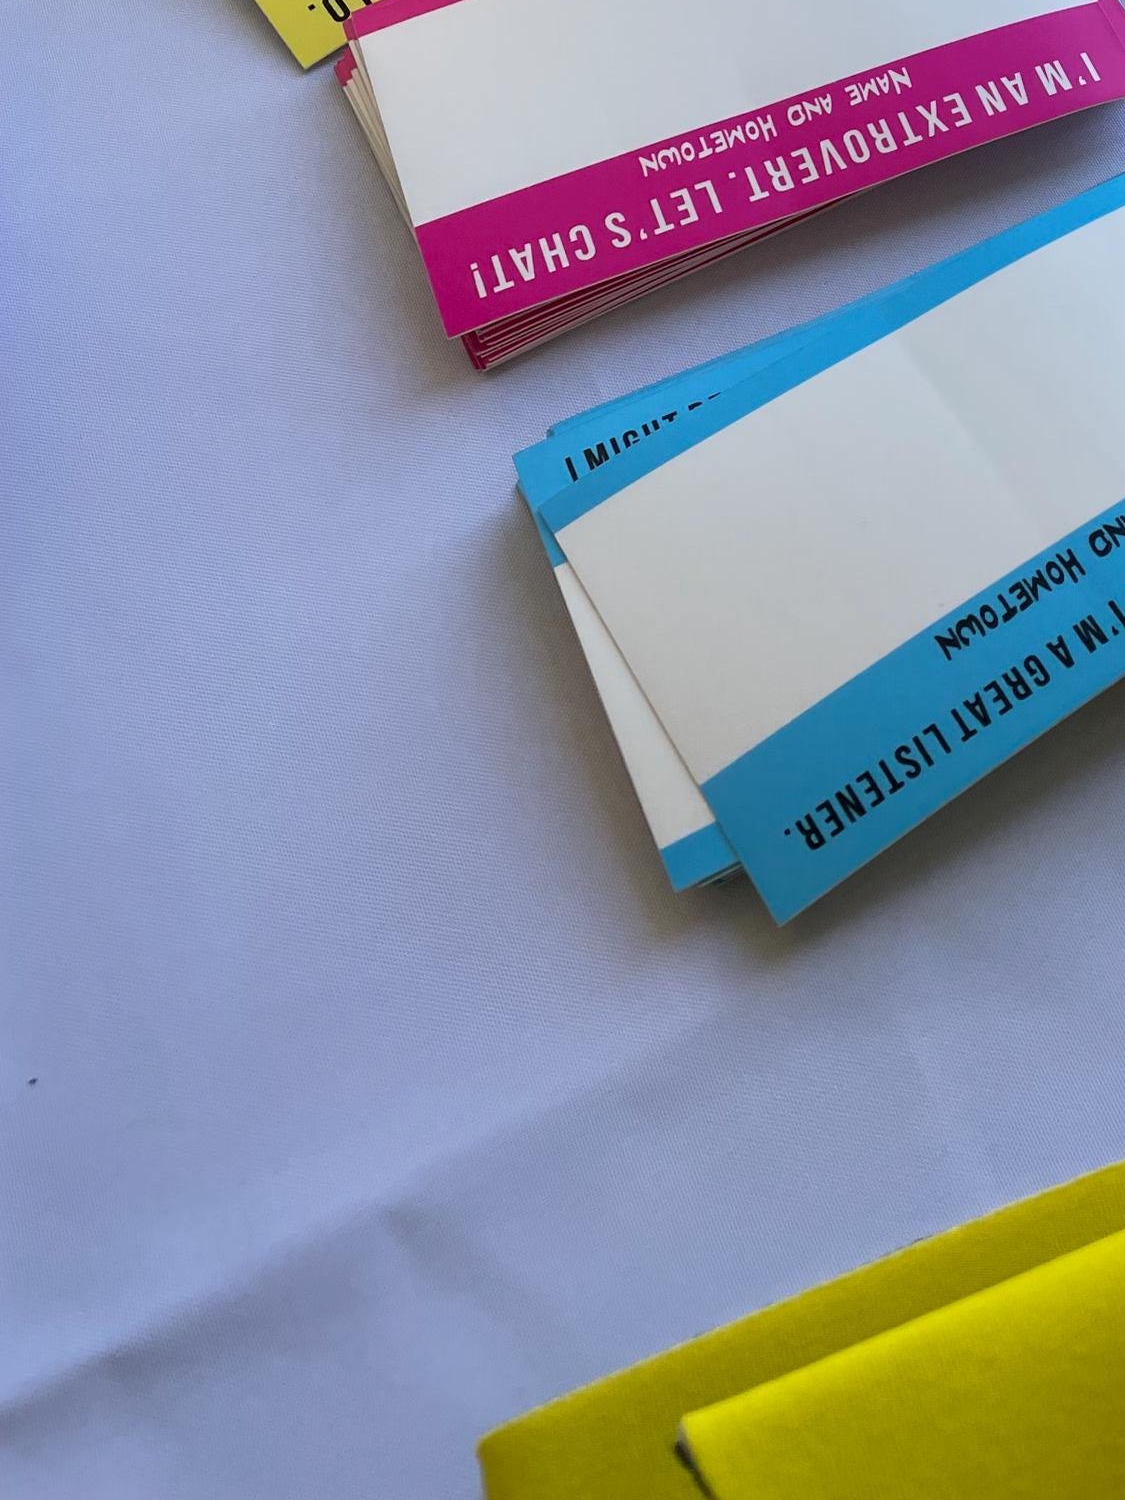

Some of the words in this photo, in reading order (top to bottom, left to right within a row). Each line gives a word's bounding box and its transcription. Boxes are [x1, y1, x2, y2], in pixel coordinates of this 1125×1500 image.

[844, 67, 913, 107] NAME
[975, 72, 1029, 116] AN
[1034, 52, 1101, 96] I'M
[786, 93, 833, 126] AND
[638, 114, 778, 178] HOMETOWN
[728, 92, 973, 202] EXTROVERT.
[604, 179, 723, 249] LET'S
[470, 224, 597, 299] CHAT!
[934, 548, 1087, 661] HOMETOWN
[1045, 634, 1076, 669] A
[950, 654, 1052, 743] GREAT
[783, 722, 953, 851] LISTENER.
